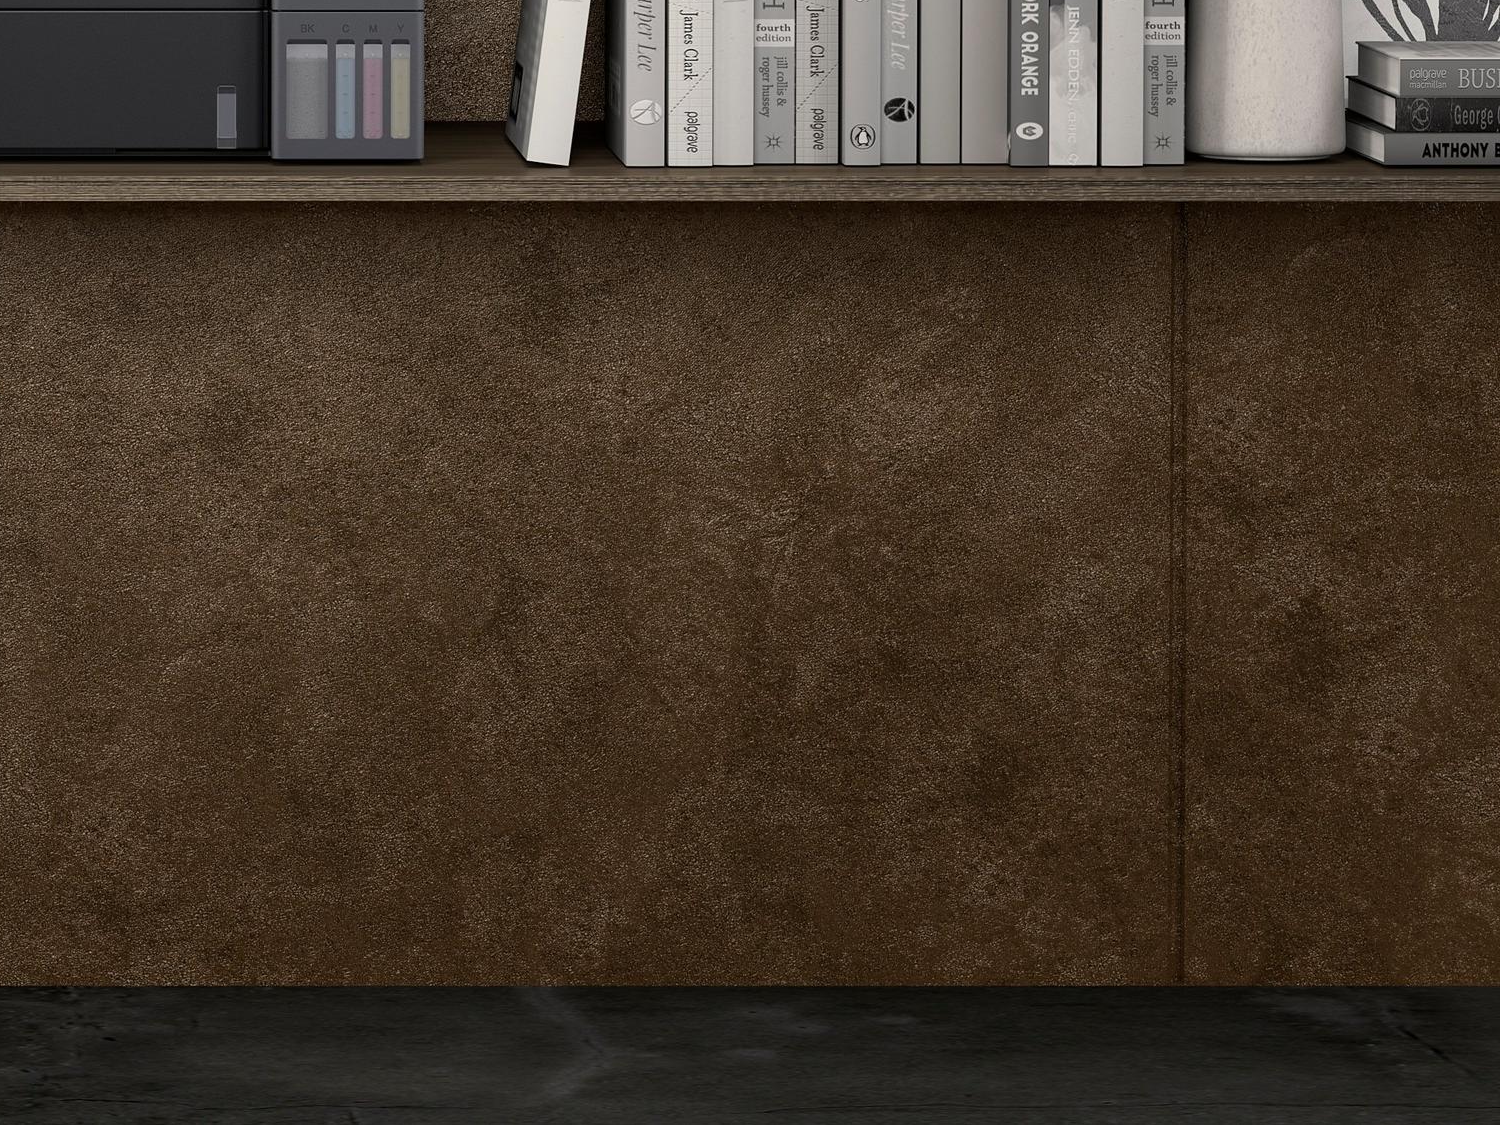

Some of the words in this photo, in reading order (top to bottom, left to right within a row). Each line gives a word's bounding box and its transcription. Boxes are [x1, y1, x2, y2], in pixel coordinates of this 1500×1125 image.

[300, 24, 315, 33] BK
[342, 24, 350, 33] C
[369, 24, 378, 33] M
[397, 24, 404, 33] Y
[679, 10, 698, 45] James
[756, 24, 791, 32] fourth
[806, 6, 825, 41] James
[1067, 5, 1080, 43] JENN
[1145, 21, 1181, 30] fourth
[1145, 31, 1181, 40] edition
[756, 34, 791, 42] edition
[638, 44, 656, 71] Lee
[684, 48, 699, 81] Clark
[774, 57, 788, 69] jill
[809, 45, 824, 77] Clark
[891, 42, 910, 70] Lee
[1020, 31, 1039, 95] ORANGE
[1148, 55, 1159, 81] roger
[1163, 55, 1178, 68] jill
[759, 57, 769, 83] roger
[1409, 68, 1447, 81] palgrave
[777, 72, 788, 96] collis
[1166, 70, 1177, 95] collis
[1409, 80, 1447, 88] macmillan
[759, 85, 774, 117] hussey
[777, 99, 787, 107] &
[1148, 84, 1163, 118] hussey
[1166, 98, 1176, 106] &
[810, 108, 826, 150] palgrave
[1454, 105, 1493, 129] George
[684, 111, 700, 153] palgrave
[1422, 142, 1488, 158] ANTHONY
